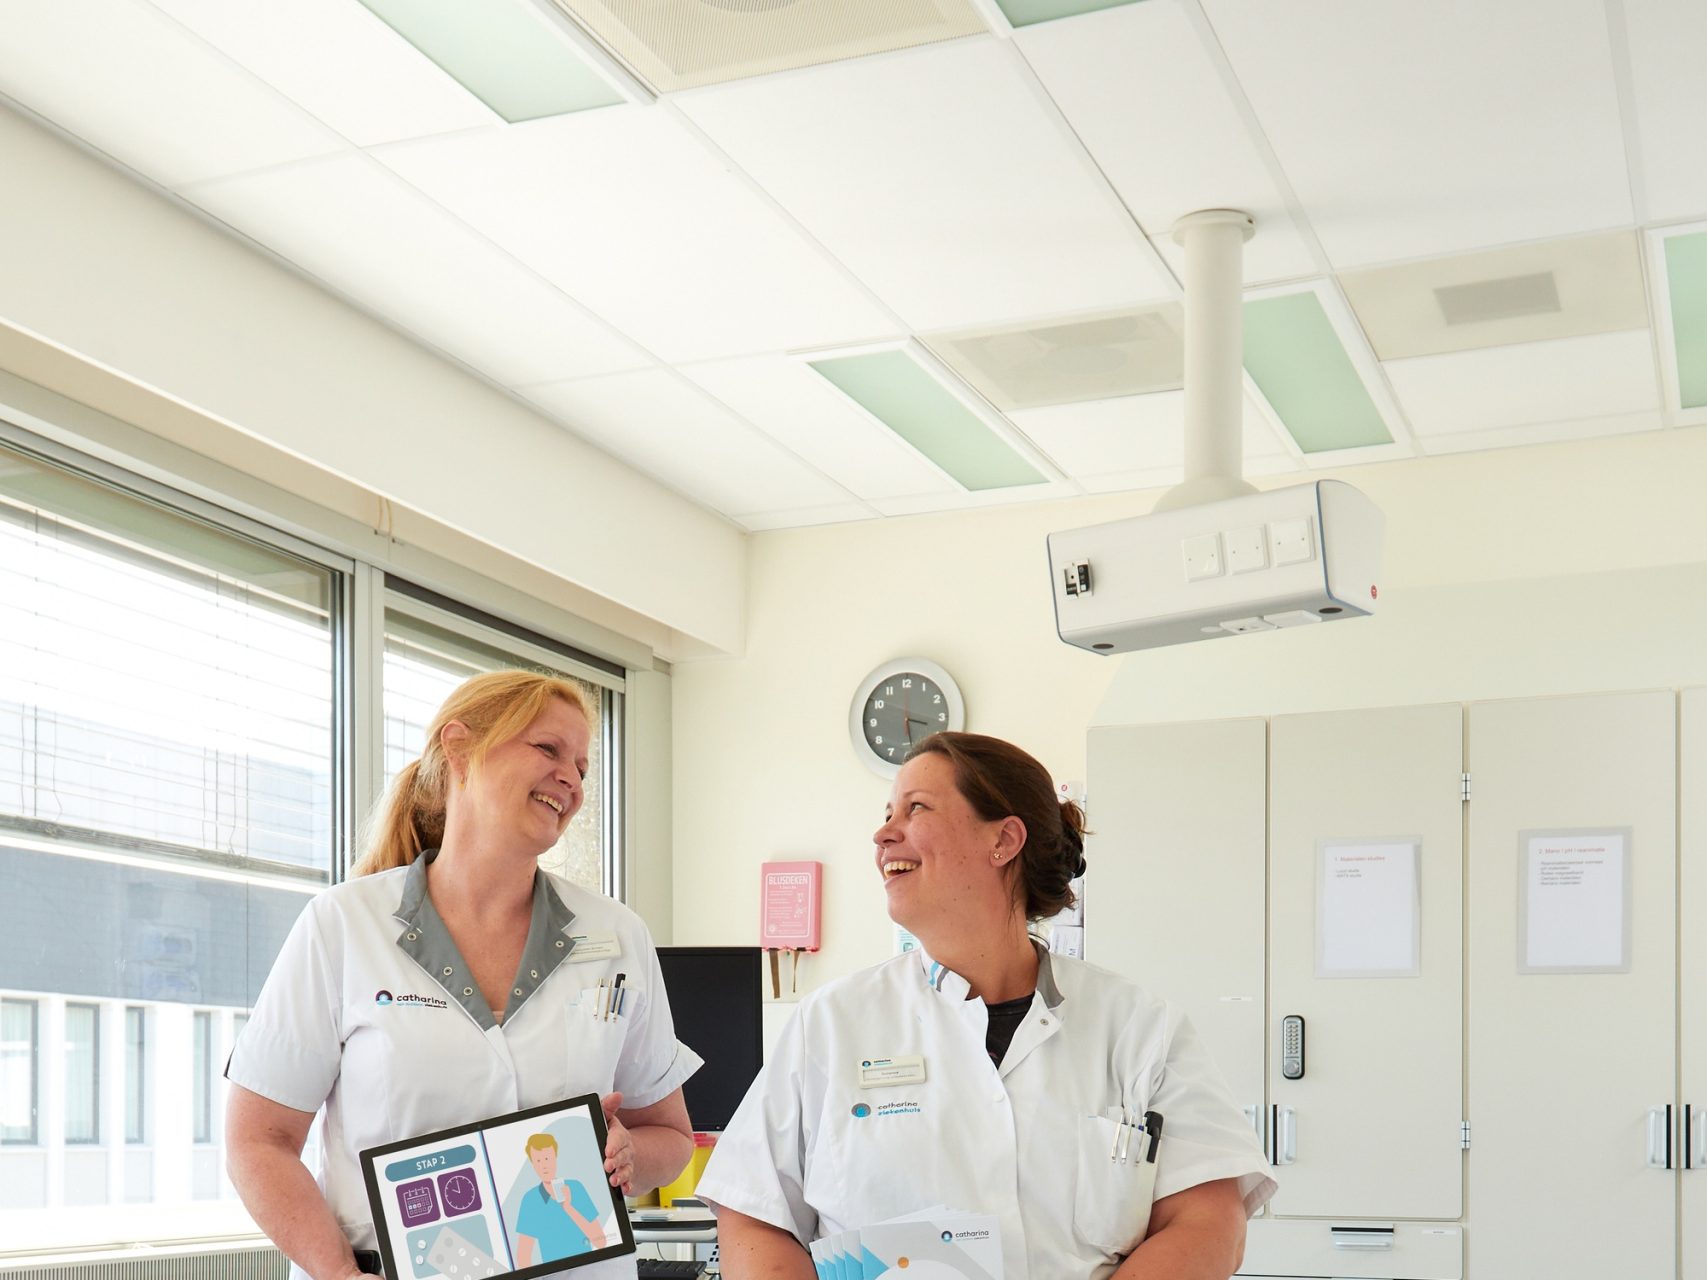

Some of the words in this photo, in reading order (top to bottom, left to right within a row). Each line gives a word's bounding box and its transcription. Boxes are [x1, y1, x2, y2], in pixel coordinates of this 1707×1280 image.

[902, 679, 912, 688] 12
[922, 682, 926, 692] 1
[886, 686, 894, 695] 11
[933, 694, 941, 704] 2
[874, 700, 884, 709] 10
[938, 713, 946, 722] 3
[870, 718, 877, 727] 9
[875, 736, 883, 744] 8
[887, 748, 895, 756] 7
[768, 875, 808, 885] BLUSDEKEN
[396, 994, 447, 1005] catharina
[878, 1101, 918, 1110] catharina
[416, 1157, 438, 1171] STAP
[440, 1155, 446, 1165] 2
[955, 1229, 989, 1238] catharina
